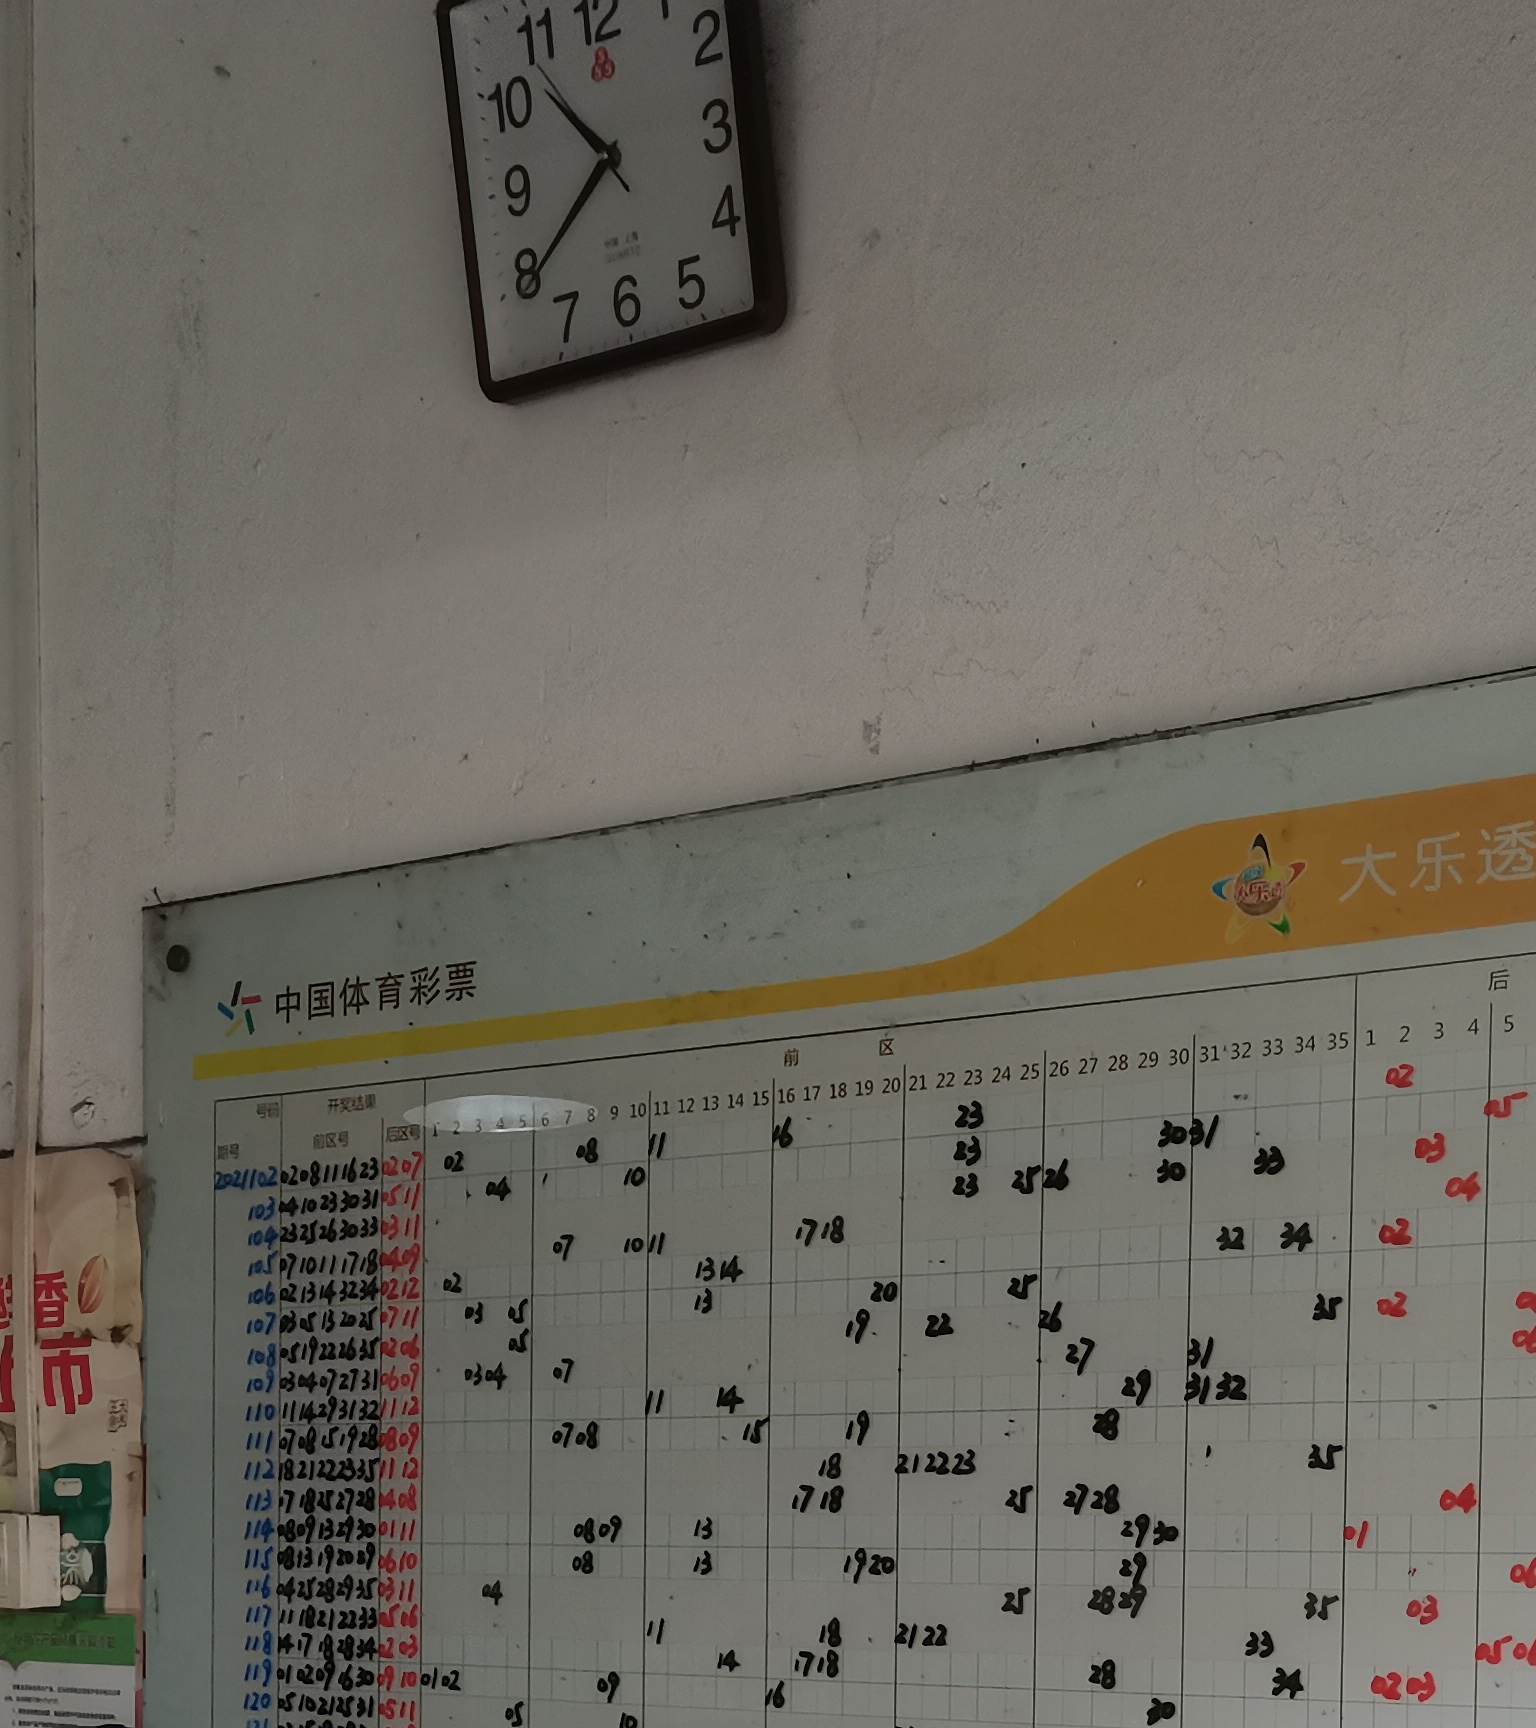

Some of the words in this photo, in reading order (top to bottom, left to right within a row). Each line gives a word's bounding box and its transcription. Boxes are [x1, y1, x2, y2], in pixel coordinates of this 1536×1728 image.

[517, 8, 554, 65] 11
[574, 1, 621, 45] 12
[692, 10, 723, 66] 2
[487, 76, 532, 132] 10
[702, 99, 732, 153] 3
[504, 165, 530, 216] 9
[712, 185, 740, 236] 4
[515, 248, 541, 299] 8
[678, 255, 705, 309] 5
[553, 291, 579, 343] 7
[613, 275, 641, 327] 6
[274, 960, 477, 1024] 中国体育彩票
[1488, 970, 1509, 991] 后
[783, 1048, 800, 1066] 前
[879, 1038, 894, 1055] 区
[1433, 1021, 1445, 1039] 3
[653, 1100, 671, 1116] 11
[702, 1095, 719, 1111] 13
[752, 1090, 770, 1107] 15
[803, 1084, 821, 1101] 17
[829, 1082, 848, 1099] 18
[855, 1079, 874, 1096] 19
[882, 1077, 901, 1094] 20
[909, 1074, 927, 1091] 21
[936, 1071, 955, 1089] 22
[964, 1068, 983, 1086] 23
[1020, 1064, 1040, 1080] 25
[1049, 1060, 1069, 1077] 26
[1108, 1055, 1129, 1072] 28
[1168, 1048, 1190, 1066] 30
[1327, 1031, 1350, 1050] 35
[1386, 1064, 1415, 1088] 02
[955, 1100, 984, 1129] 23
[1483, 1091, 1528, 1118] 05
[1253, 1146, 1285, 1174] 33
[1415, 1132, 1446, 1163] 03
[215, 1165, 278, 1190] 2021102
[248, 1196, 276, 1221] 103
[624, 1167, 645, 1187] 10
[796, 1218, 817, 1246] 17
[821, 1215, 844, 1243] 18
[1216, 1225, 1245, 1251] 32
[870, 1281, 898, 1302] 20
[246, 1604, 272, 1629] 117
[647, 1617, 664, 1645] 11
